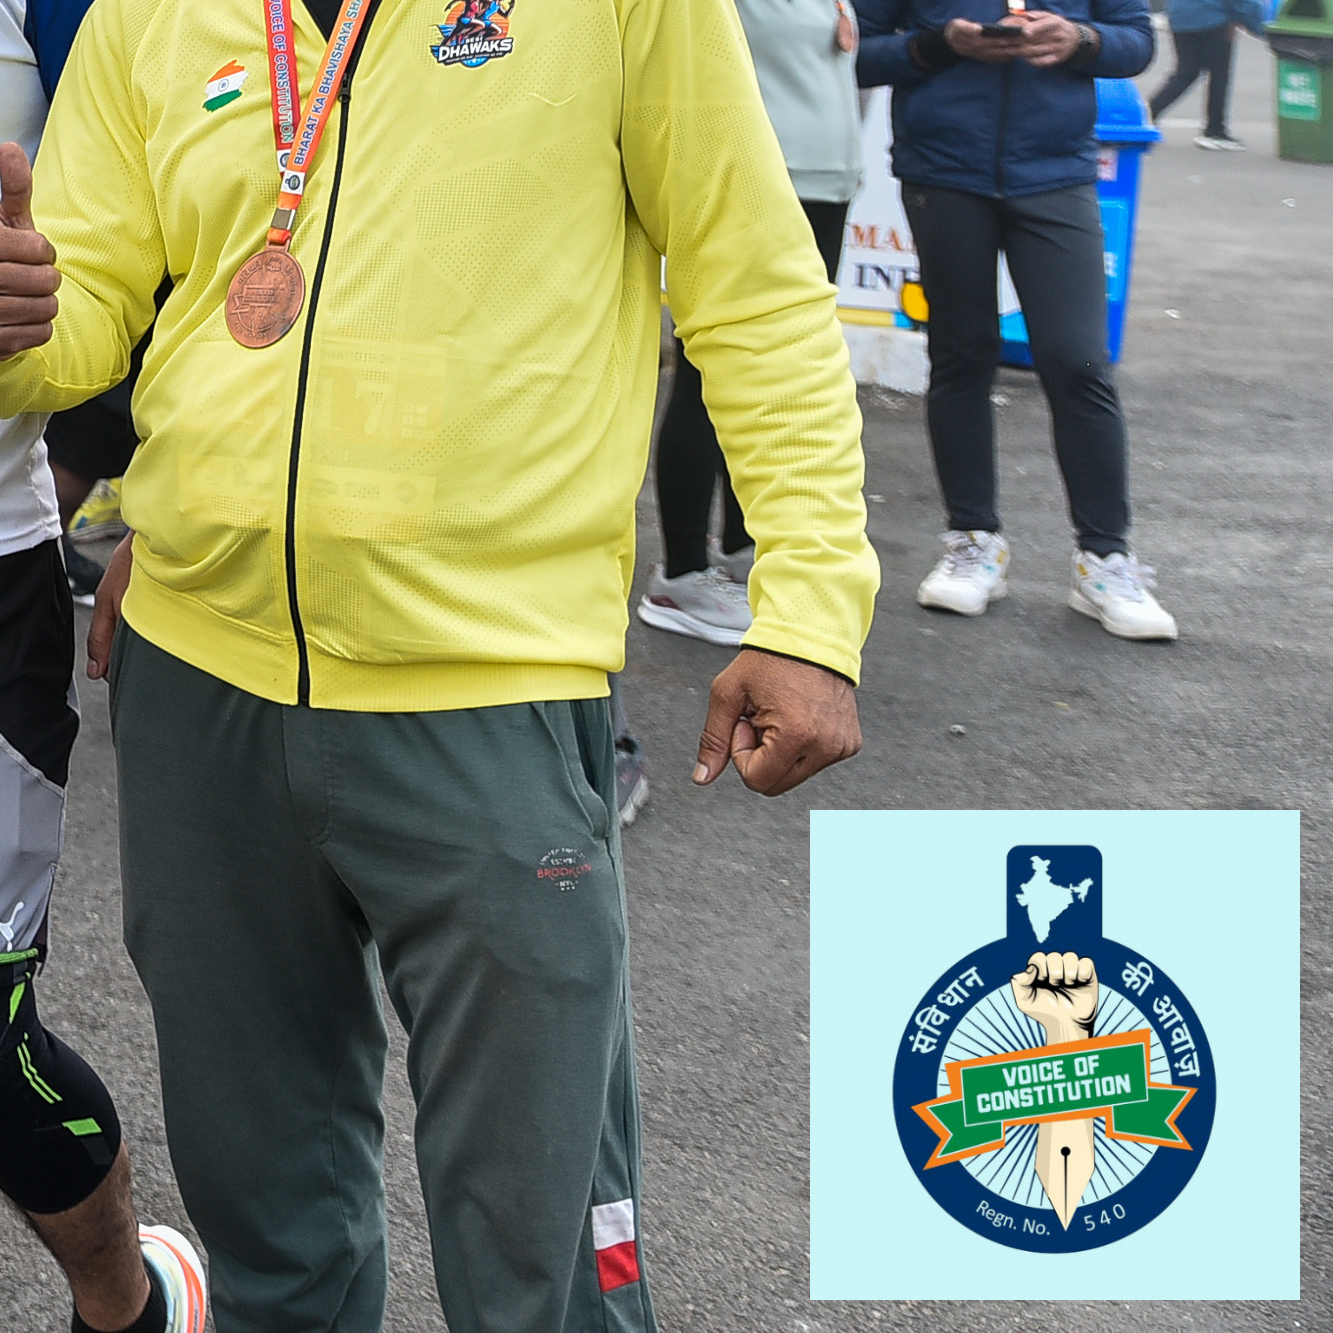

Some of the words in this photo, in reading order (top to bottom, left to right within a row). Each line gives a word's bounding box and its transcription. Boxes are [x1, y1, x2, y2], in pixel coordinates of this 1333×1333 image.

[273, 34, 287, 50] OF
[318, 20, 354, 97] BHAVISHAYA
[438, 38, 513, 62] DHAWAKS
[275, 53, 294, 144] CONSTITUTION
[311, 96, 326, 116] KA
[293, 115, 320, 166] BHARAT
